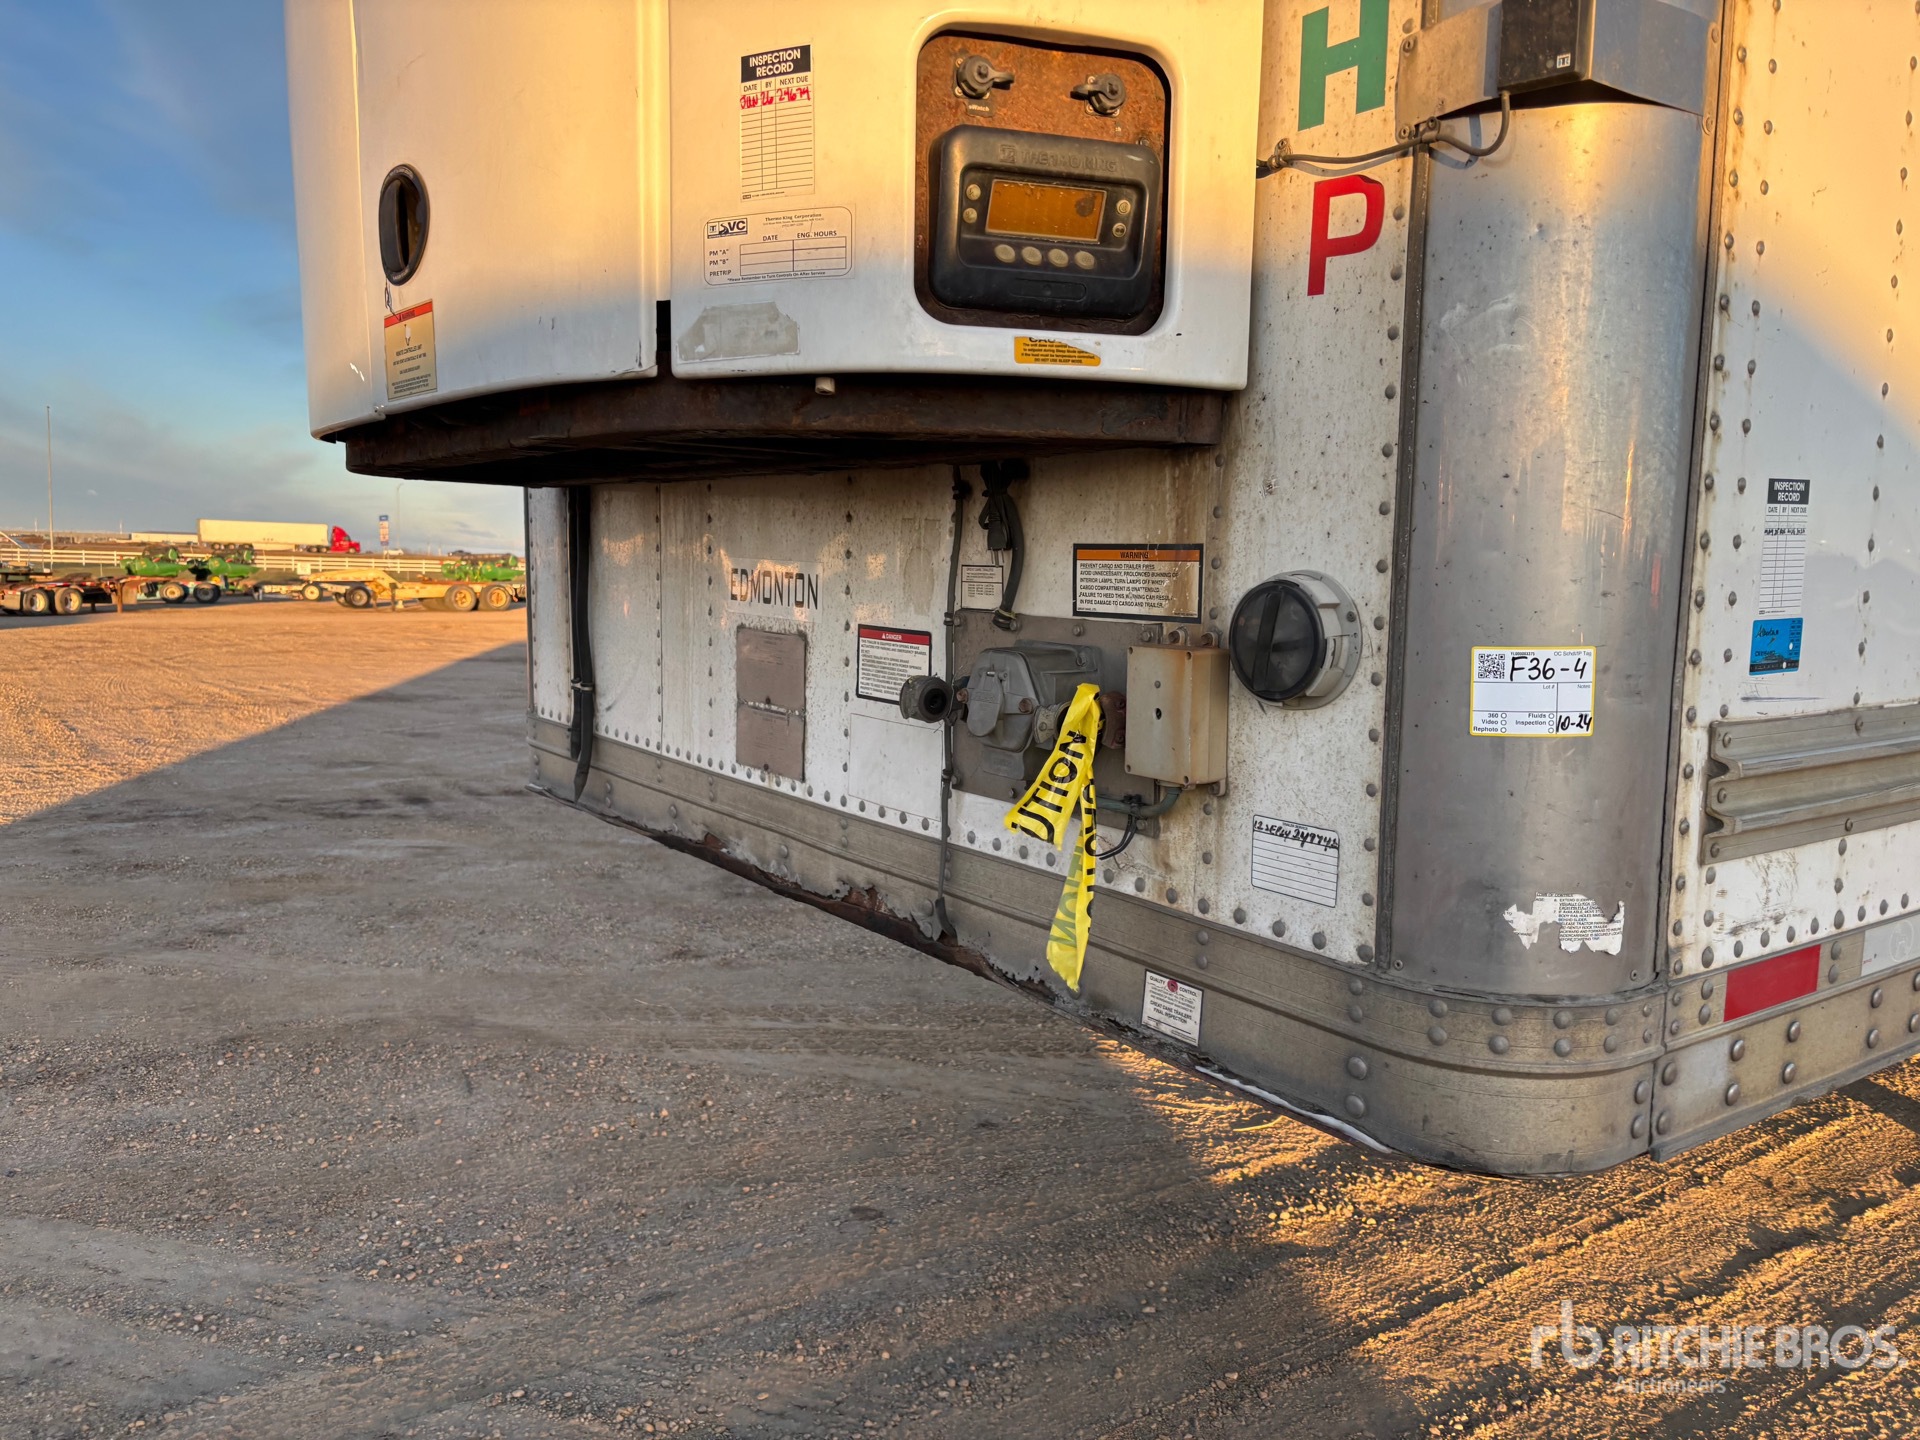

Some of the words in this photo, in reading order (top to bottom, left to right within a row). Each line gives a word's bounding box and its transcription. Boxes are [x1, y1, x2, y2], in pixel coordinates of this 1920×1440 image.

[750, 49, 800, 67] INSPECTION
[1298, 0, 1389, 131] H
[756, 62, 794, 77] RECORD
[744, 84, 758, 92] DATE
[1022, 150, 1081, 169] THERMO
[1084, 154, 1117, 172] KING
[1307, 174, 1385, 296] P
[1774, 481, 1805, 491] INSPECTION
[1778, 492, 1800, 501] RECORD
[730, 568, 818, 610] EDMONTON
[1510, 656, 1587, 681] F36-4
[1150, 976, 1165, 984] QUALITY
[1179, 987, 1197, 997] CONTROL
[1150, 1000, 1162, 1009] GREAT
[1174, 1009, 1192, 1020] TRAILERS
[1165, 1012, 1187, 1024] INSPECTION
